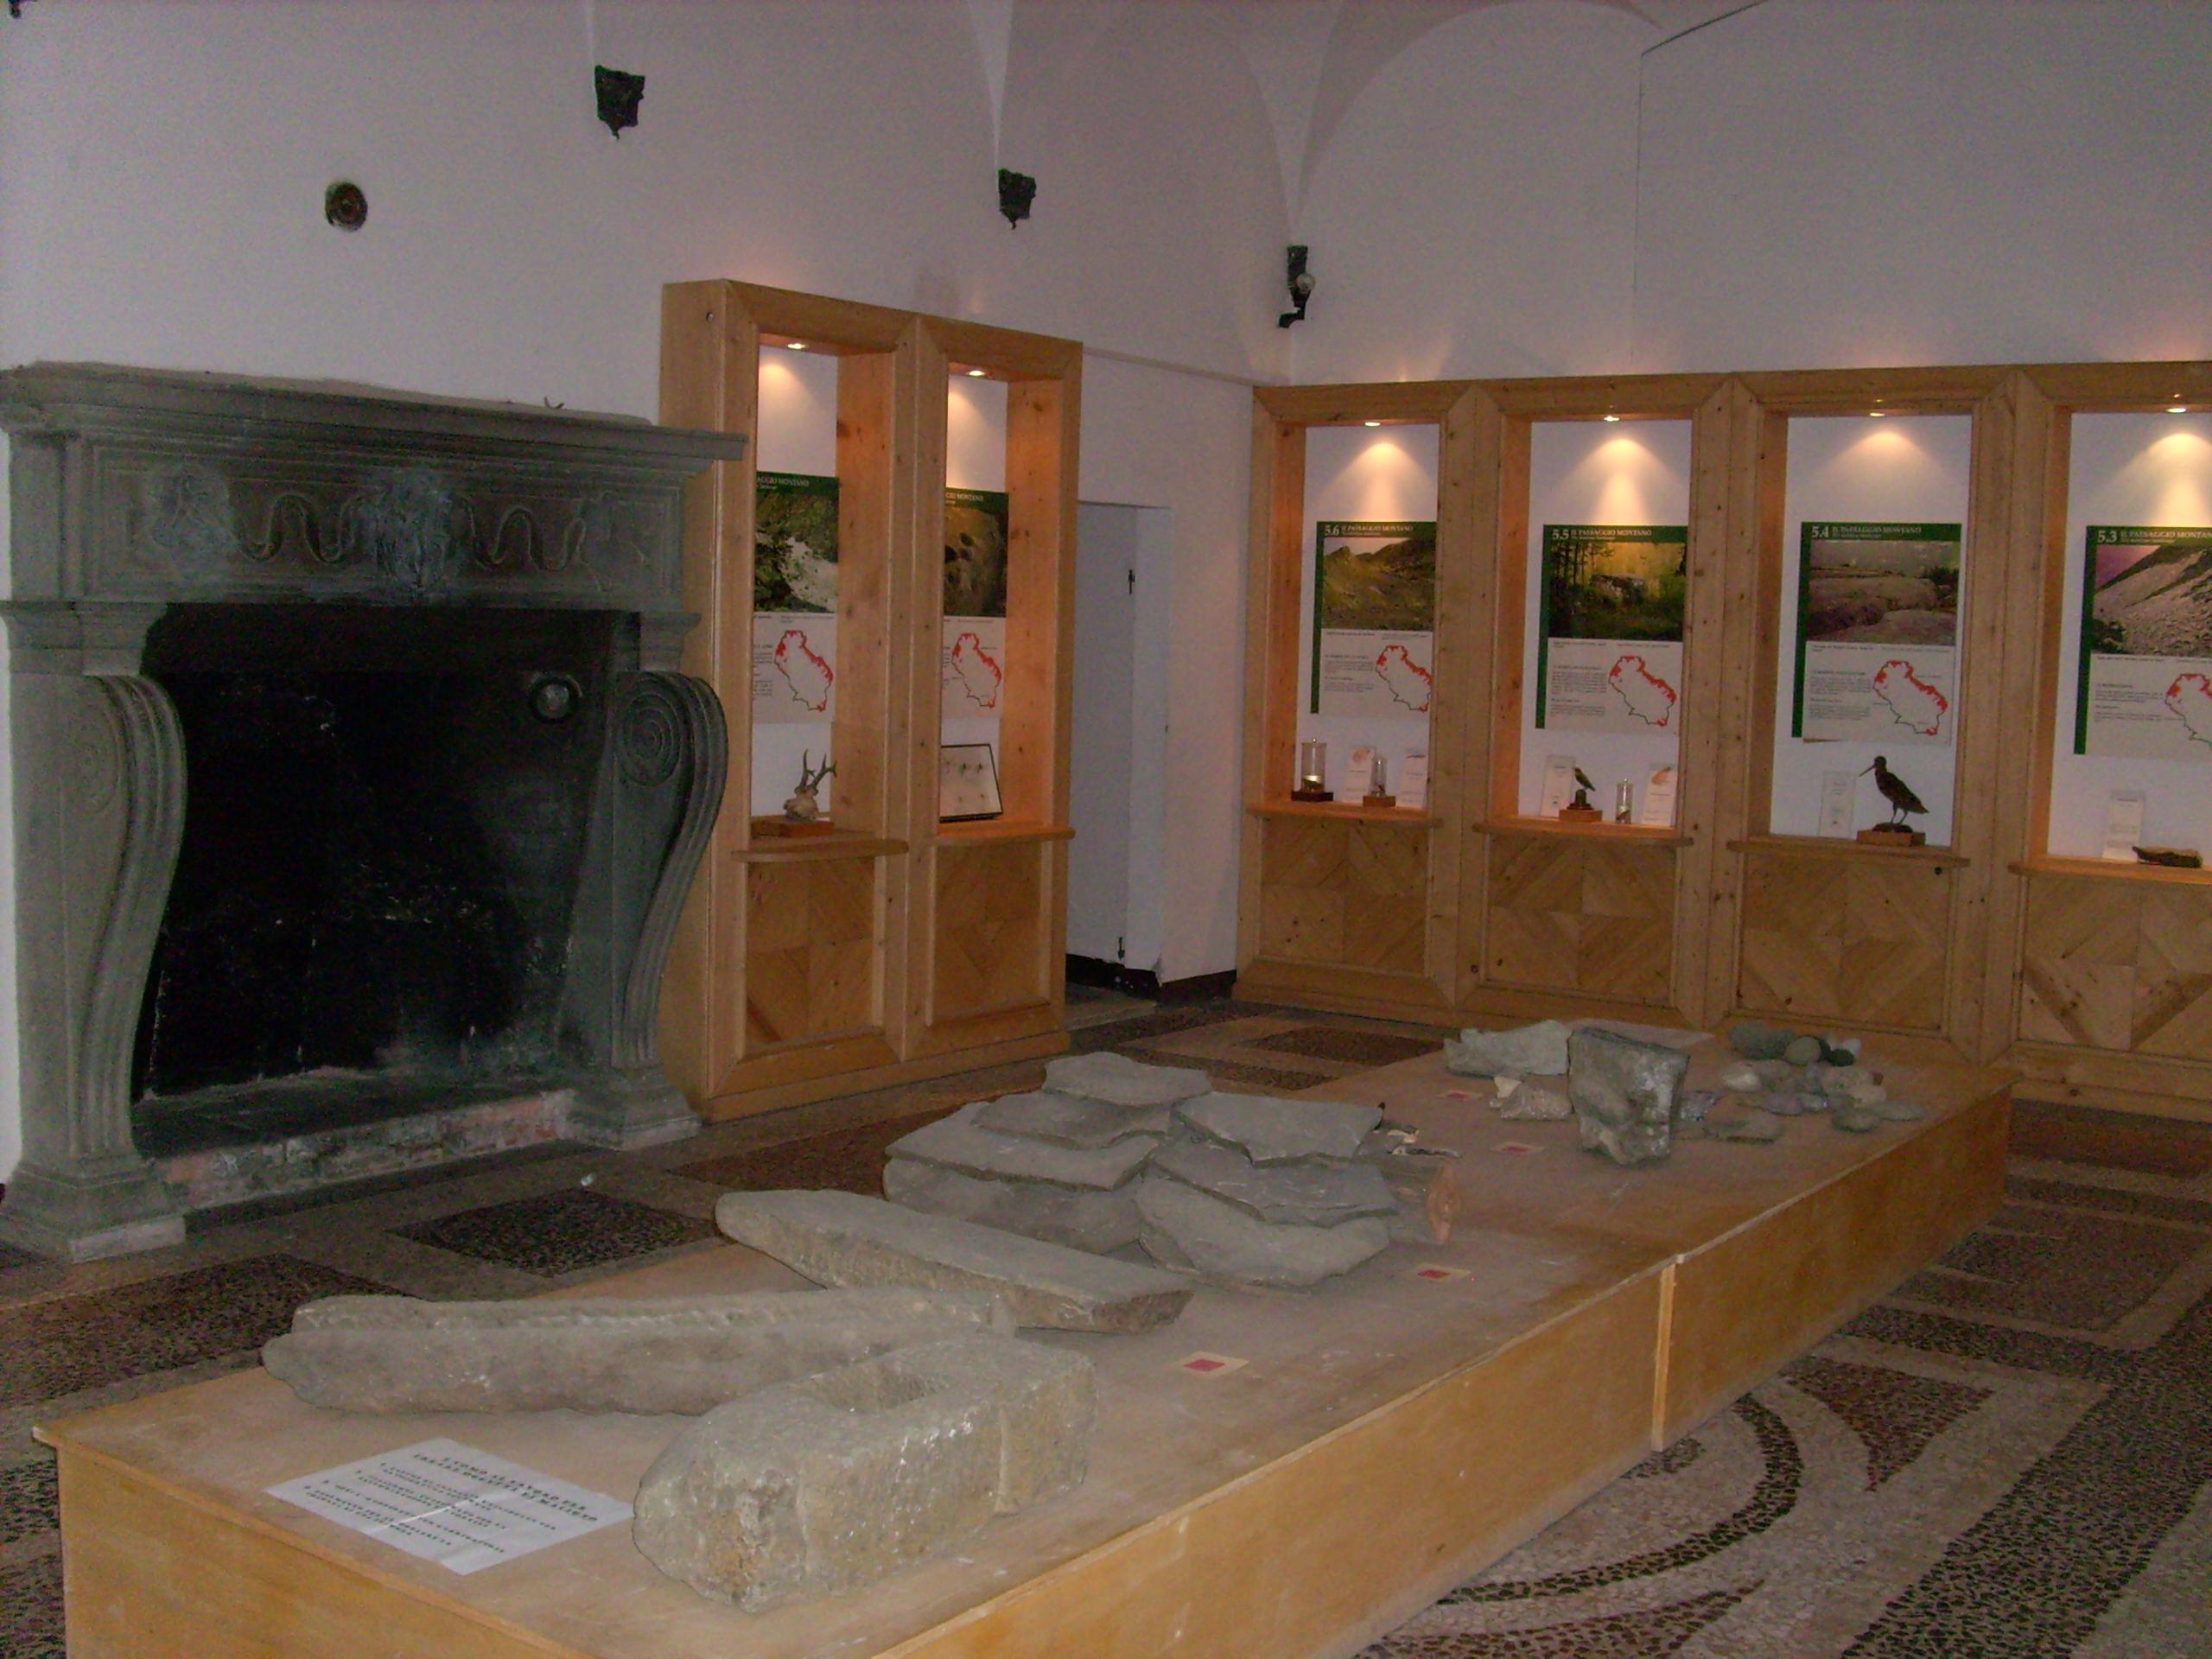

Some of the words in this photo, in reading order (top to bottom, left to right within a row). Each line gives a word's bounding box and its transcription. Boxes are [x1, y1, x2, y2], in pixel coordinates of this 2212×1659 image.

[1325, 525, 1339, 537] 5.6
[1552, 528, 1570, 540] 5.5
[2097, 531, 2117, 543] 5.3
